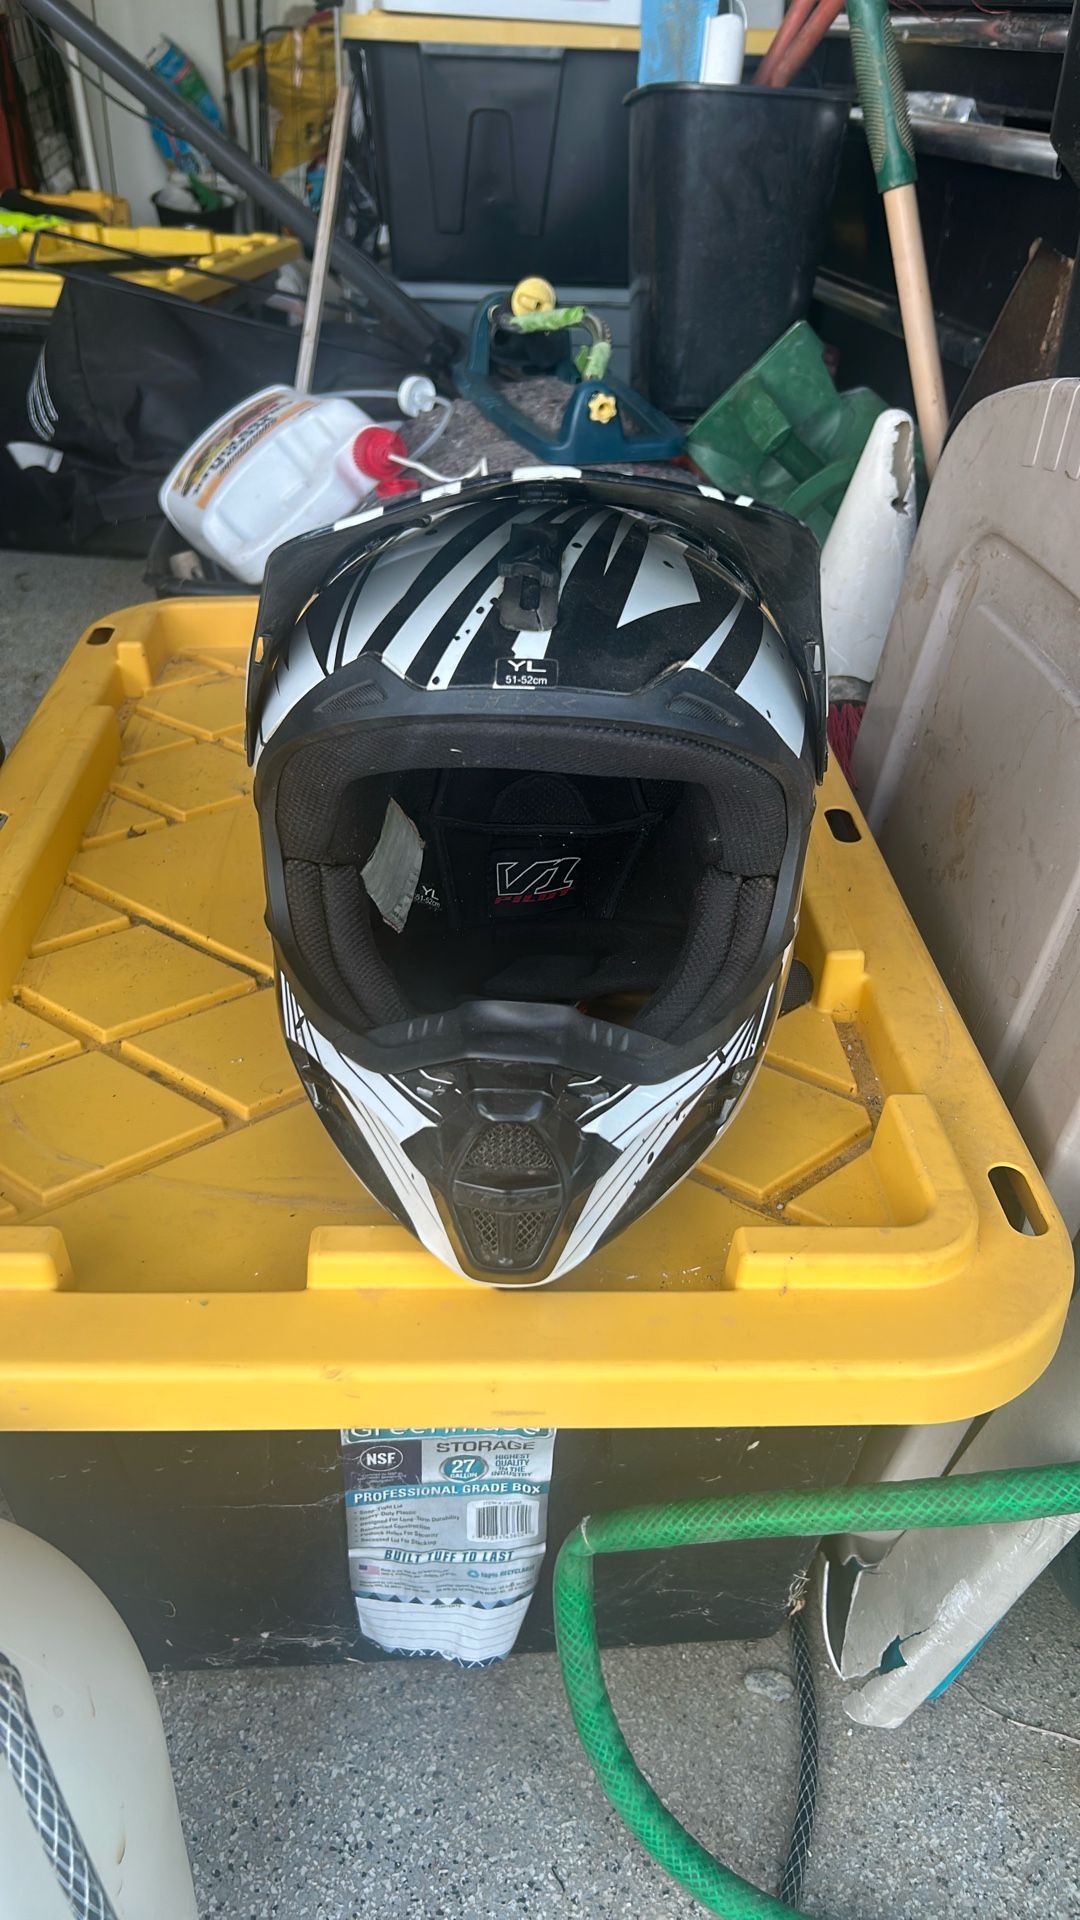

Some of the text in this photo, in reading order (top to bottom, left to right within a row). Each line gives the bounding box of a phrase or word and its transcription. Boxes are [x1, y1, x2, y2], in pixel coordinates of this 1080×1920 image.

[507, 660, 547, 673] YL
[505, 675, 548, 685] 51-52cm
[496, 857, 581, 896] V1
[422, 885, 440, 901] YL
[436, 1441, 536, 1453] STORAGE
[366, 1452, 395, 1466] NSF
[451, 1459, 476, 1473] 27
[354, 1482, 541, 1504] PROFESSIONAL GRADE BOX
[384, 1549, 515, 1563] BUILT TUFF TO LAST
